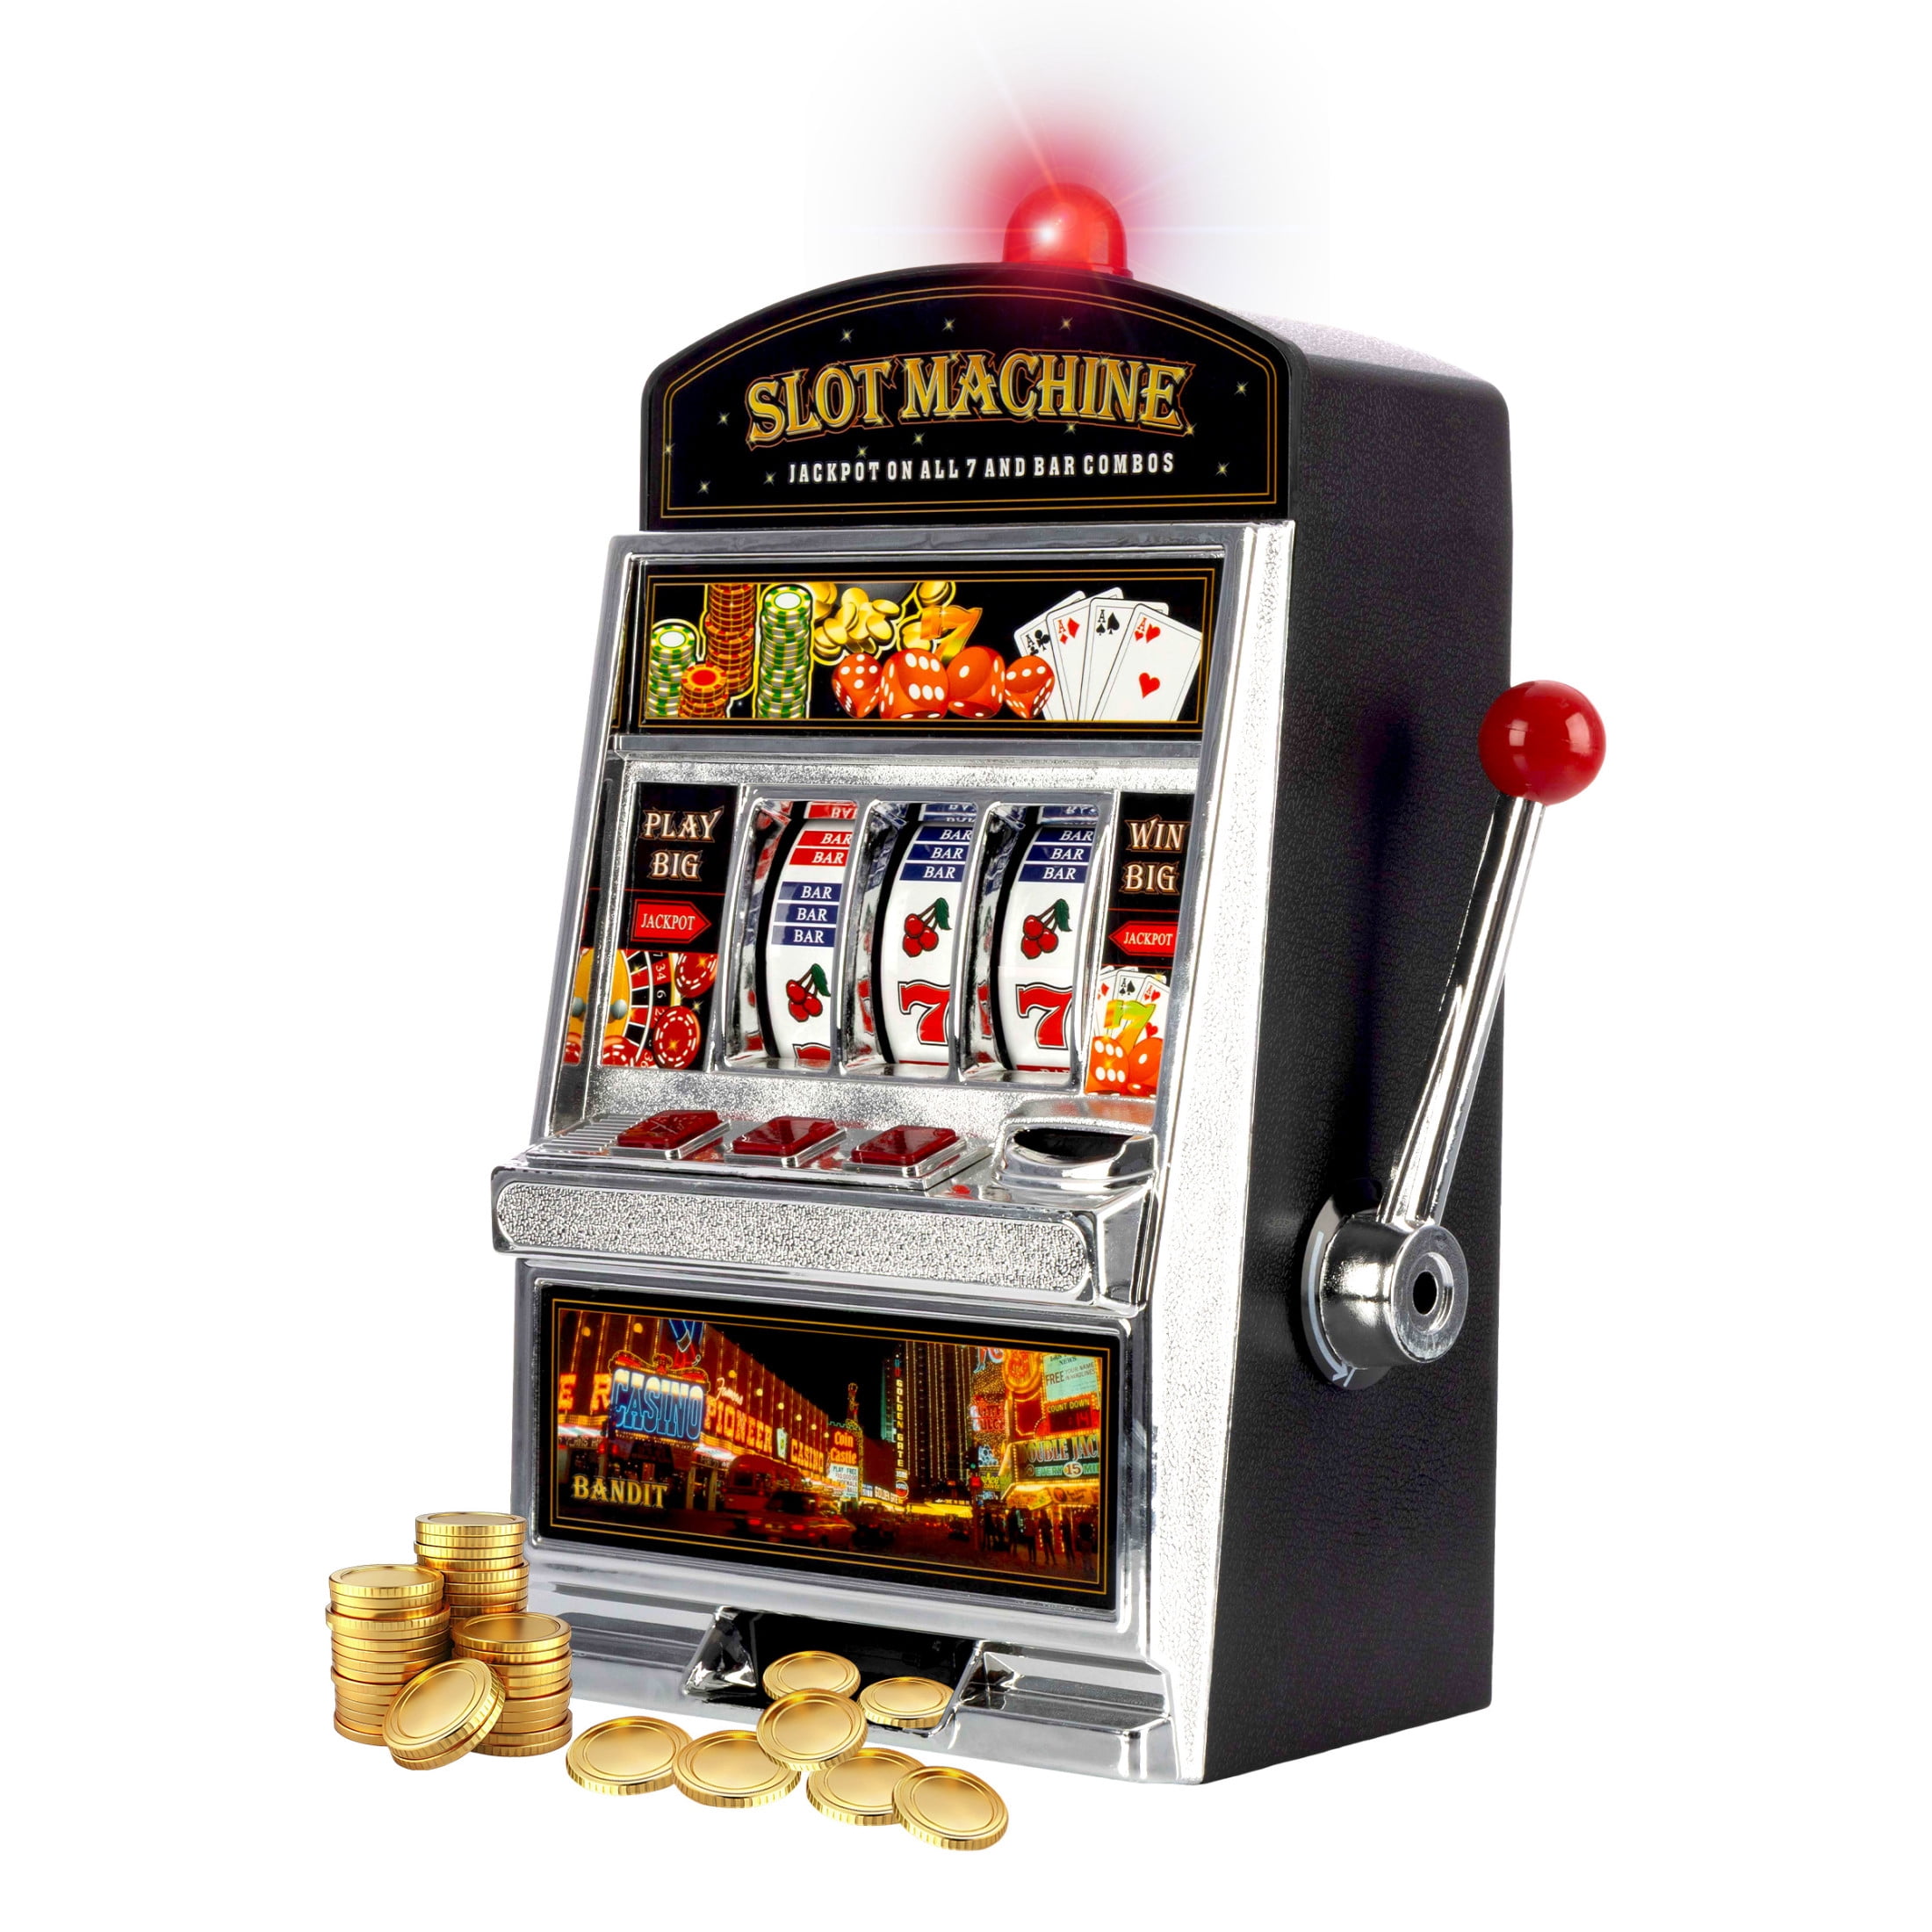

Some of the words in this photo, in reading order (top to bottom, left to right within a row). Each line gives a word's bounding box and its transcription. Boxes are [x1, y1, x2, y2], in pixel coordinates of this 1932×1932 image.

[746, 358, 894, 444] SLOT
[901, 351, 1191, 432] MACHINE
[789, 460, 880, 483] JACKPOT
[887, 460, 912, 480] ON
[919, 458, 958, 479] ALL
[967, 458, 977, 479] 7
[984, 457, 1025, 478] AND
[1034, 455, 1075, 476] BAR
[1084, 452, 1174, 475] COMBOS
[1098, 609, 1106, 623] A
[1057, 619, 1066, 634] A
[1137, 617, 1147, 632] A
[1026, 634, 1034, 648] A
[643, 808, 723, 841] PLAY
[1059, 831, 1093, 841] BAR
[1129, 817, 1186, 851] WIN
[811, 852, 844, 864] BAR
[930, 847, 962, 860] BAR
[1049, 848, 1083, 861] BAR
[650, 851, 702, 880] BIG
[923, 867, 955, 879] BAR
[1042, 867, 1076, 880] BAR
[1124, 862, 1177, 893] BIG
[801, 885, 832, 899] BAR
[640, 913, 696, 931] JACKPOT
[797, 908, 827, 921] BAR
[793, 930, 825, 943] BAR
[1123, 932, 1173, 946] JACKPOT
[656, 990, 667, 998] 6
[898, 979, 950, 1046] 7
[1015, 982, 1072, 1050] 7
[1046, 1371, 1065, 1386] FREE
[611, 1368, 703, 1441] CASINO
[895, 1379, 904, 1429] GOLDEN
[1047, 1404, 1067, 1414] COUNT
[1069, 1398, 1090, 1409] DOWN
[703, 1394, 773, 1457] PIONEER
[834, 1431, 854, 1447] Coin
[896, 1432, 905, 1467] GATE
[1071, 1434, 1100, 1461] JAC
[790, 1438, 824, 1474] CASINO
[831, 1447, 857, 1465] Castle
[1065, 1463, 1081, 1475] 15
[573, 1474, 667, 1509] BANDIT
